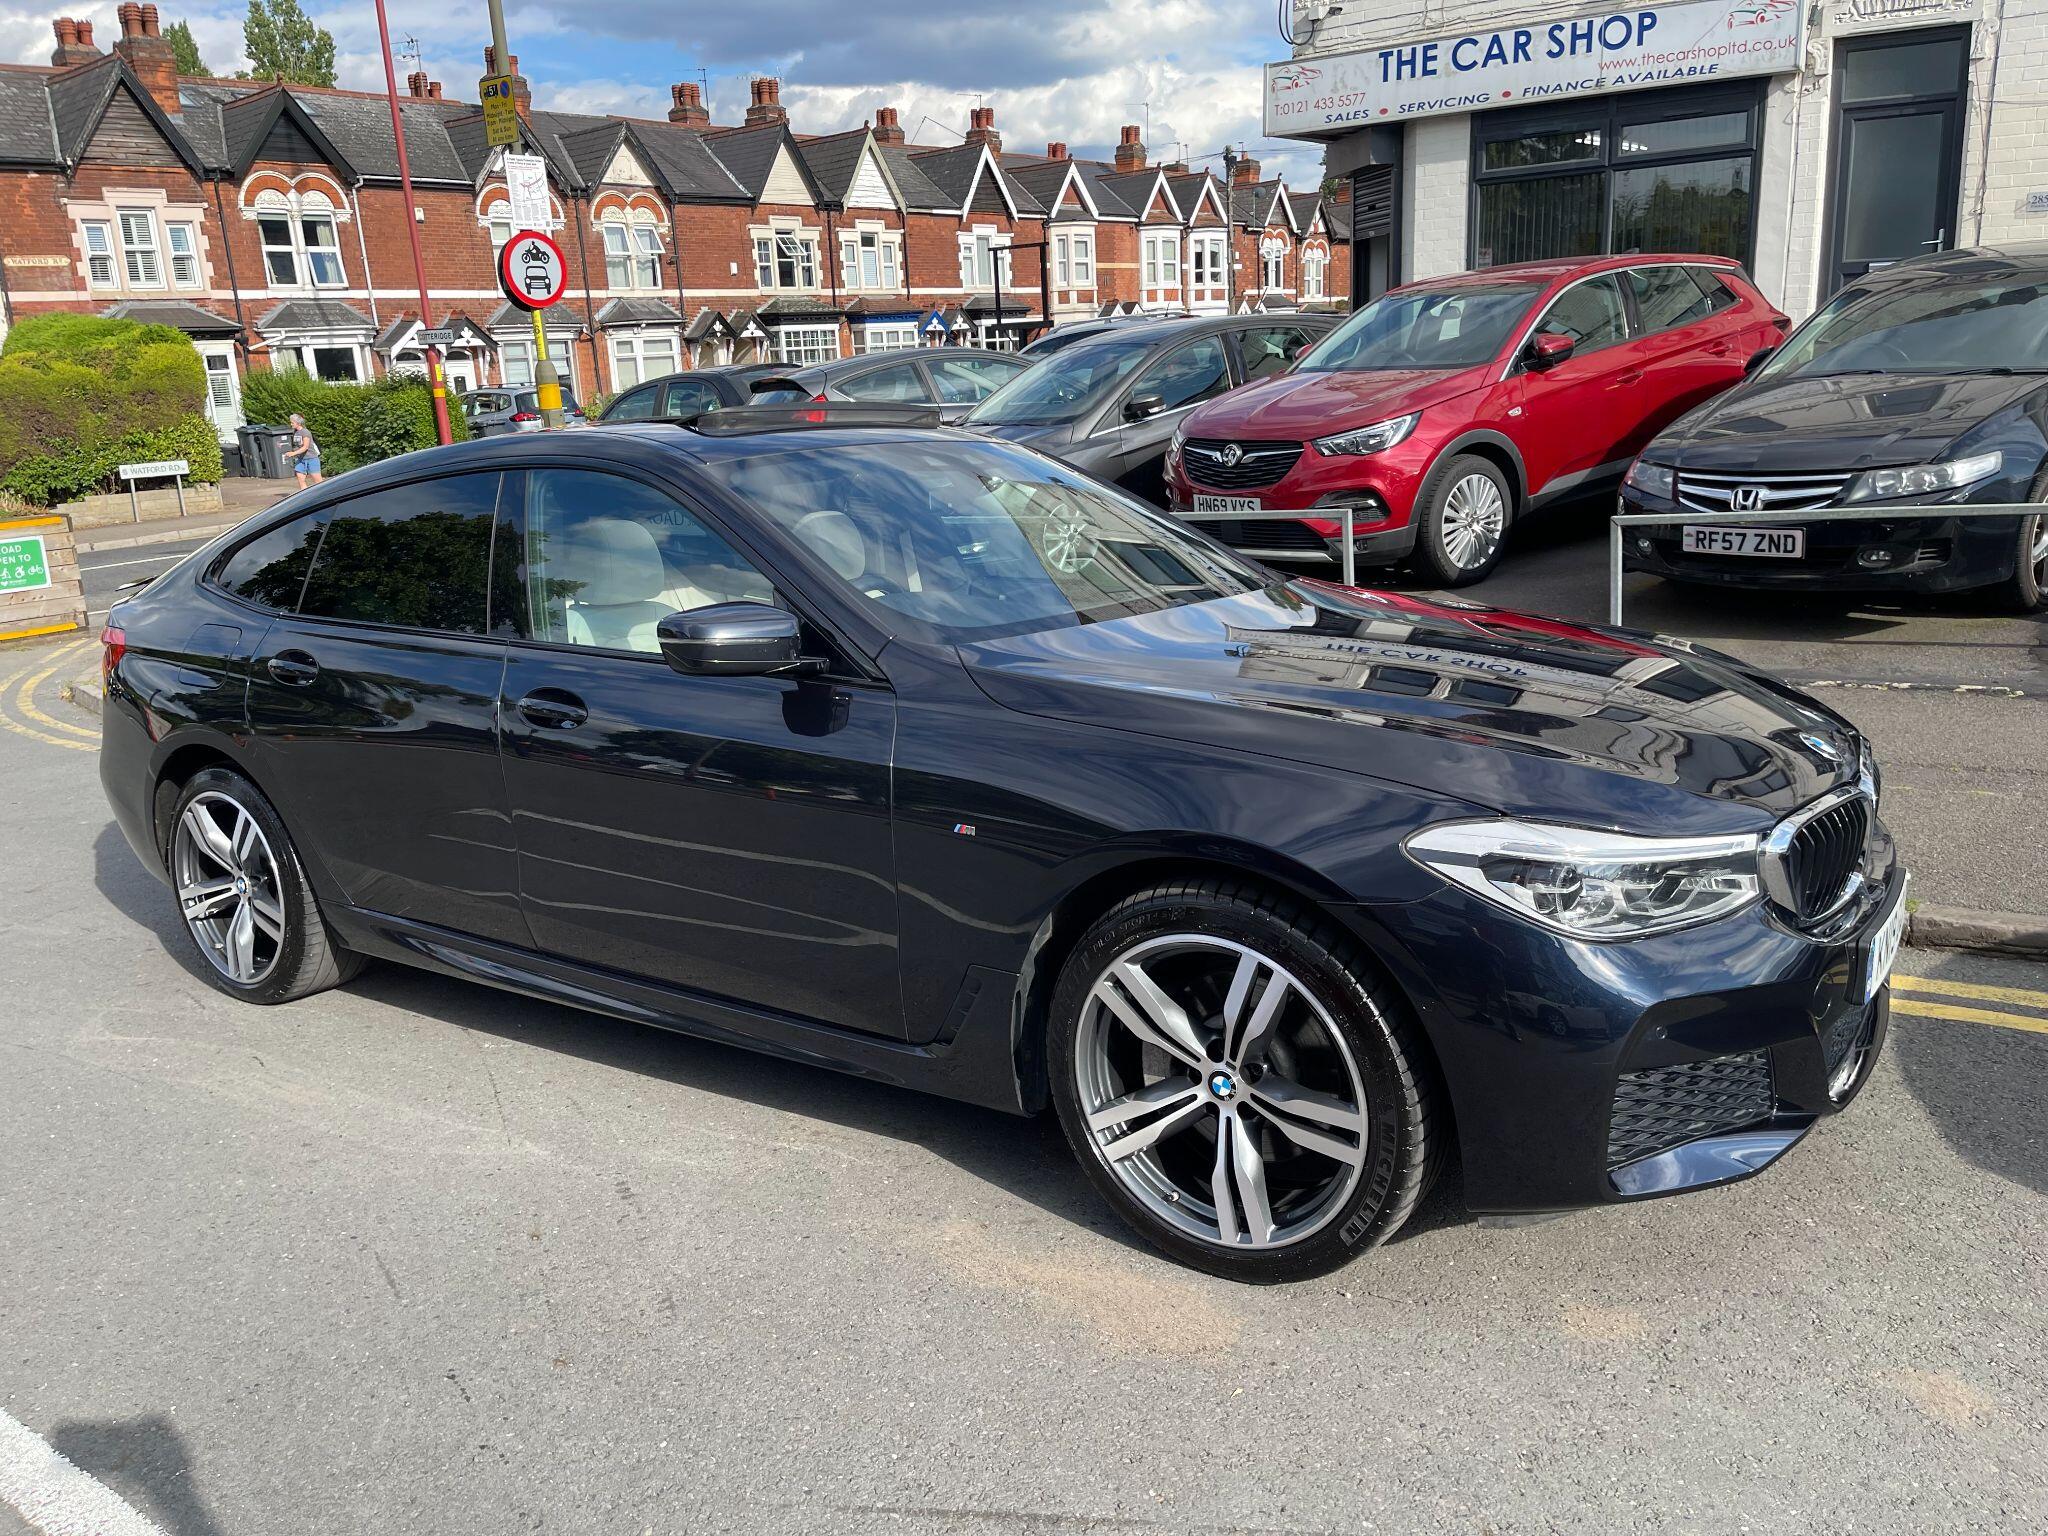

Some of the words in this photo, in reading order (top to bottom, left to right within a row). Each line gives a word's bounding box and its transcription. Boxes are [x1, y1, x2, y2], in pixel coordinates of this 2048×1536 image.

[1378, 43, 1439, 83] THE
[1451, 29, 1532, 72] CAR
[1545, 11, 1657, 59] SHOP
[1598, 34, 1797, 71] www.thecarshopltd.co.uk
[1274, 100, 1309, 117] T:0121
[1313, 96, 1334, 111] 433
[1337, 92, 1366, 108] 5577
[1324, 109, 1370, 124] SALES
[1398, 93, 1490, 114] SERVICING
[1522, 77, 1607, 97] FINANCE
[1612, 63, 1719, 86] AVAILABLE
[130, 465, 167, 475] WATFORD
[168, 464, 180, 472] RD
[1197, 496, 1228, 513] HN69
[0, 545, 22, 555] OAD
[1695, 530, 1747, 552] RF57
[1753, 533, 1796, 554] ZND
[0, 555, 16, 565] EN
[18, 553, 31, 563] TO
[1345, 1120, 1397, 1240] MICHELIN
